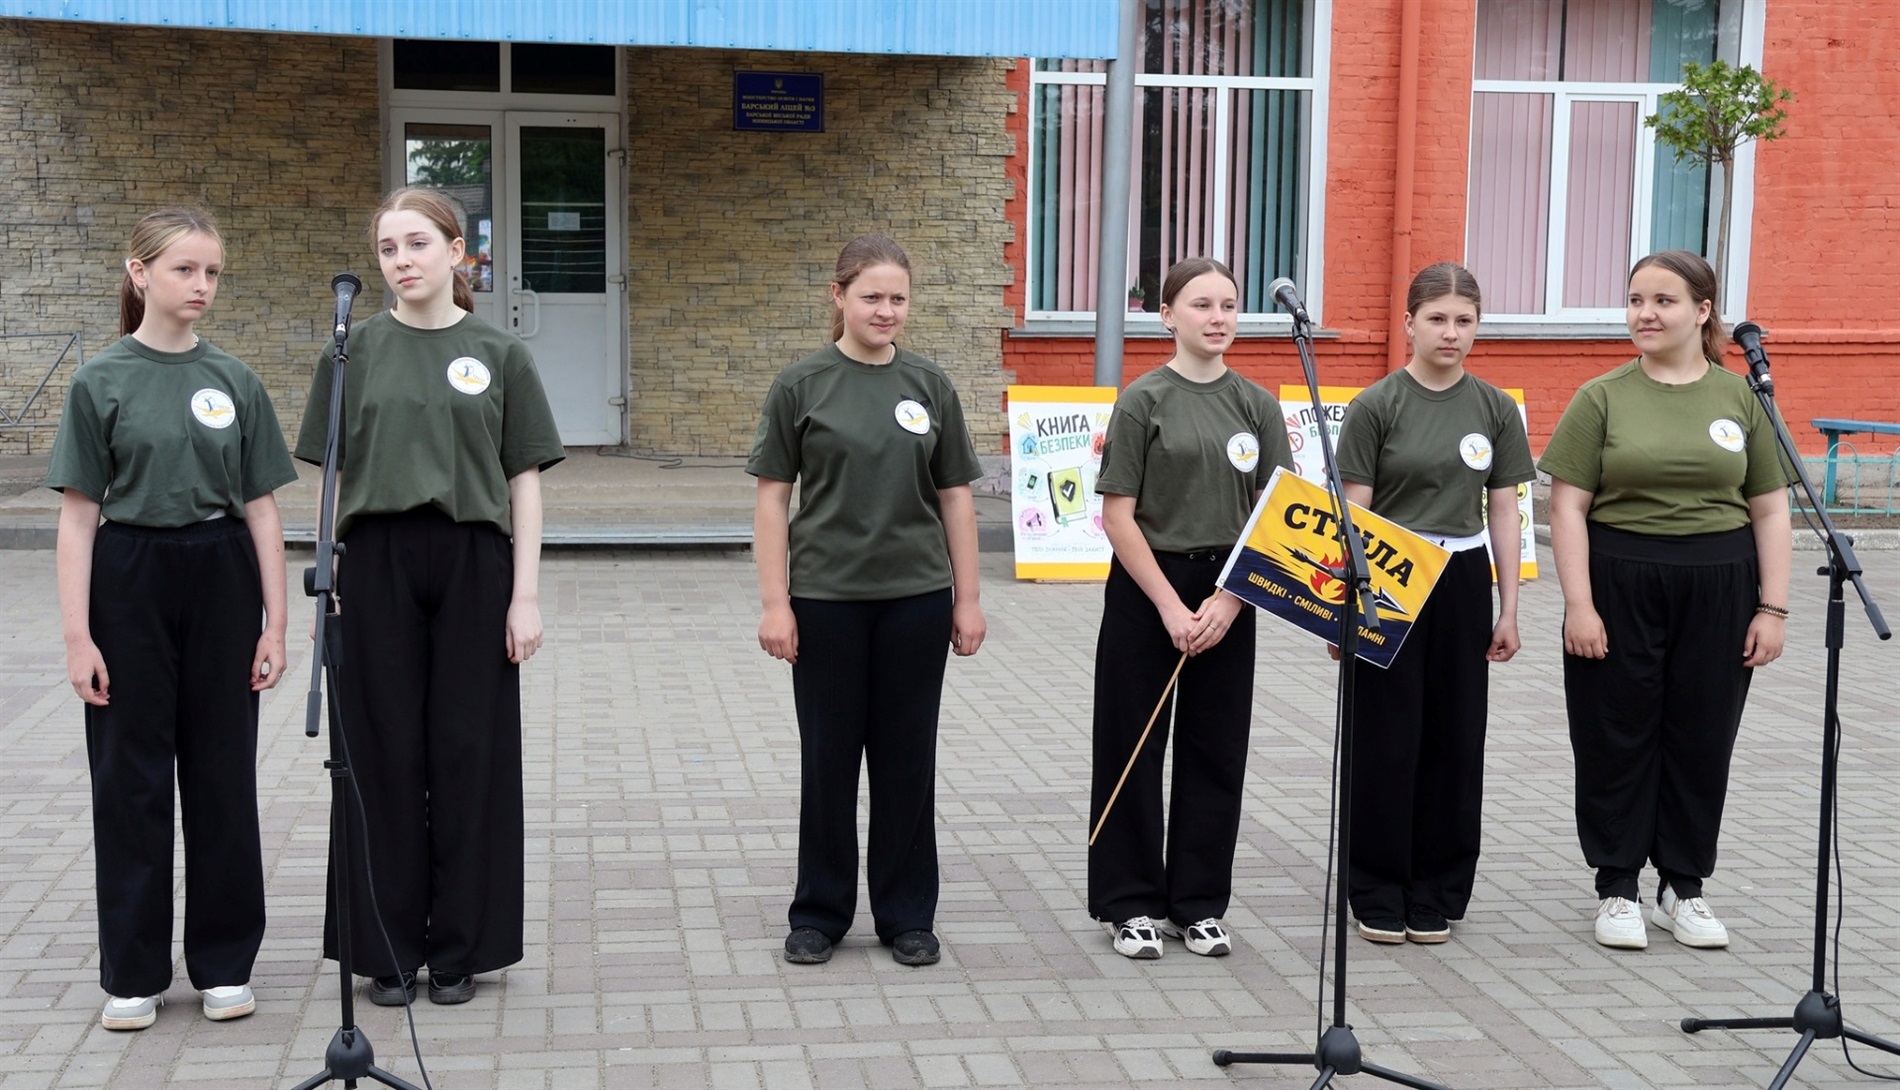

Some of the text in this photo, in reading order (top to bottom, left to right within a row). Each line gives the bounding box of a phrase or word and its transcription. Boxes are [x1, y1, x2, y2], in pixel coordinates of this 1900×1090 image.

[1036, 414, 1091, 437] КНИГА
[1040, 434, 1091, 455] БЕЗПЕКИ
[1248, 572, 1287, 598] ШВИДКІ
[1294, 595, 1333, 621] СМІЛИВІ
